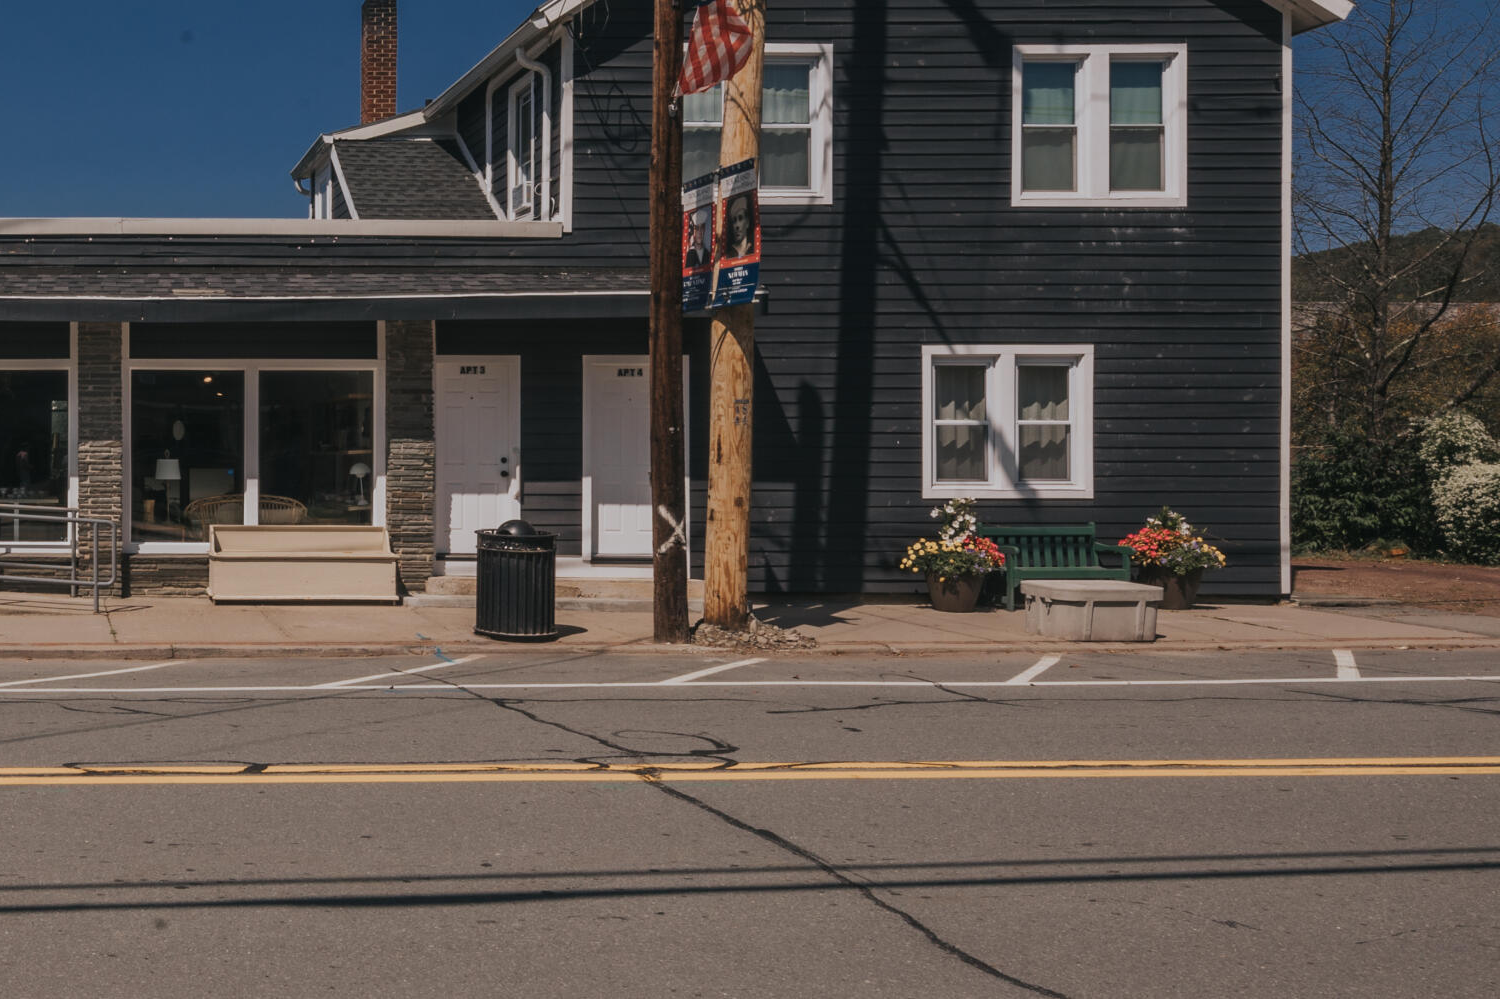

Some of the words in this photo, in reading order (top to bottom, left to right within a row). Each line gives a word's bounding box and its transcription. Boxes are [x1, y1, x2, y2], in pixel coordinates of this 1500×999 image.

[460, 366, 478, 375] APT
[480, 366, 486, 375] 3
[617, 368, 636, 377] APT
[637, 368, 643, 377] 4
